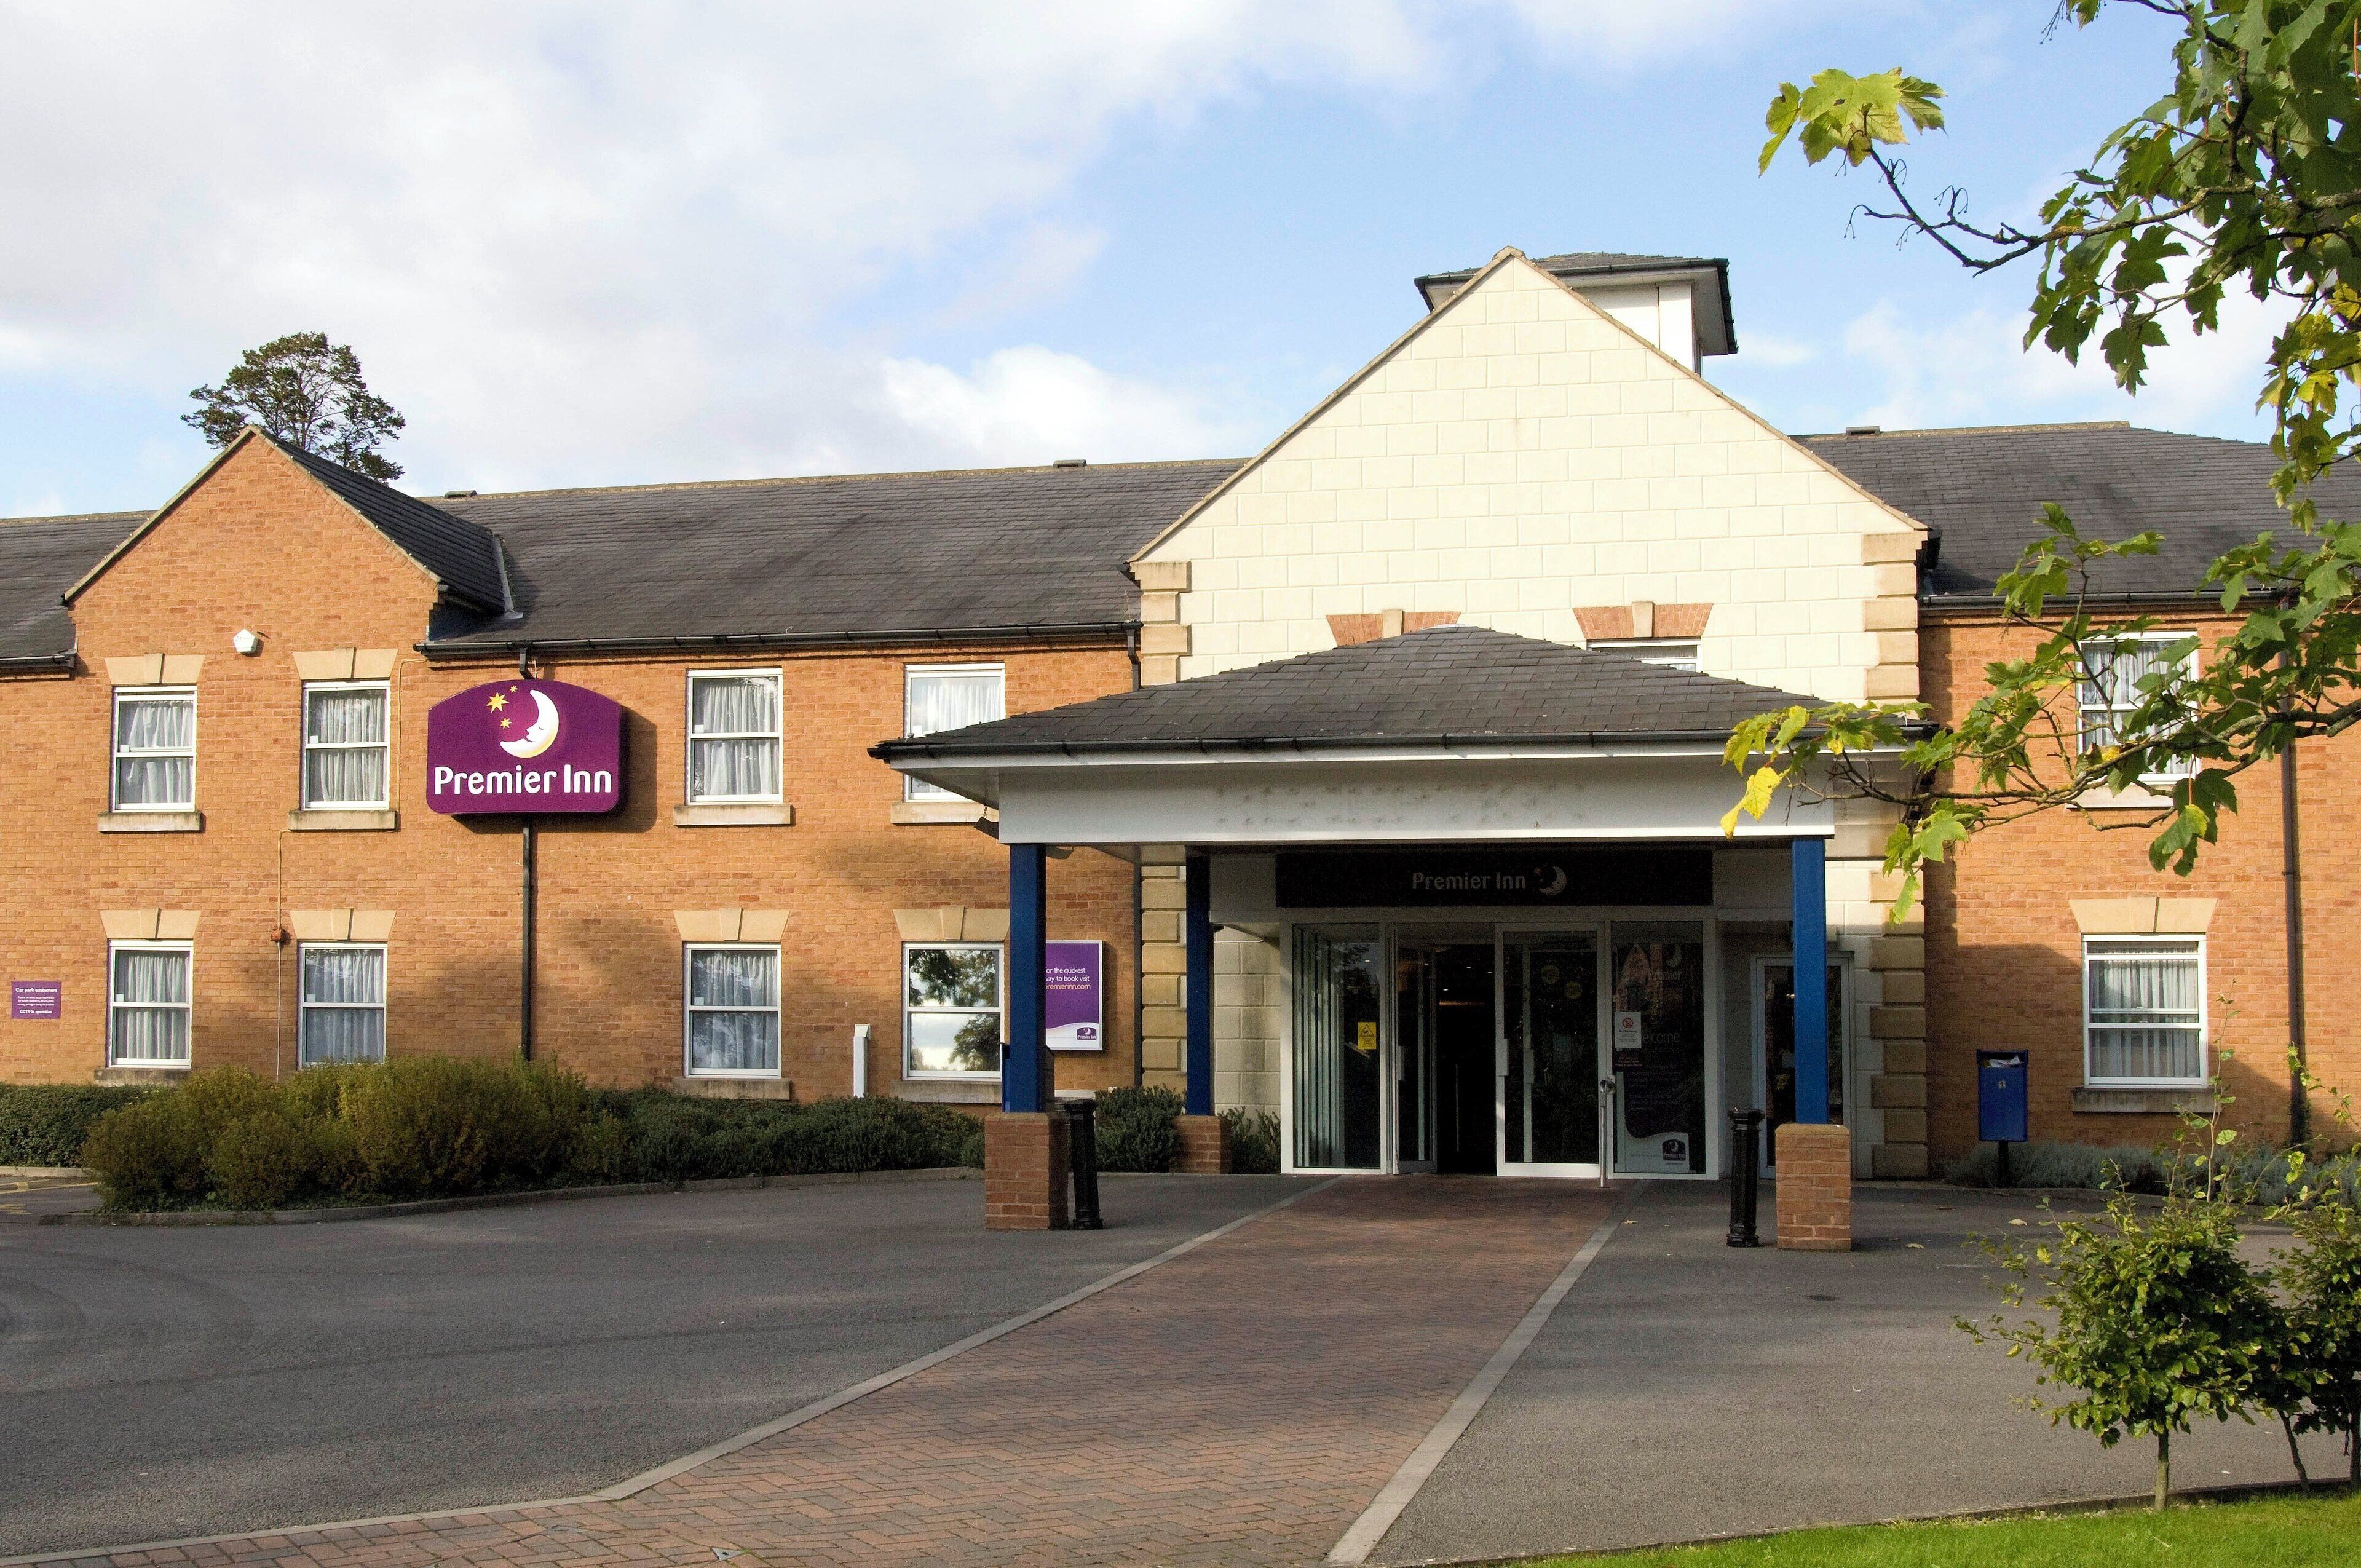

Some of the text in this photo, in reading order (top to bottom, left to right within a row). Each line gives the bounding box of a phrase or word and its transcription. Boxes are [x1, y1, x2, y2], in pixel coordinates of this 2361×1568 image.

[434, 764, 612, 795] Premier Inn
[1412, 871, 1526, 890] Premier Inn
[1642, 1029, 1681, 1043] elcome
